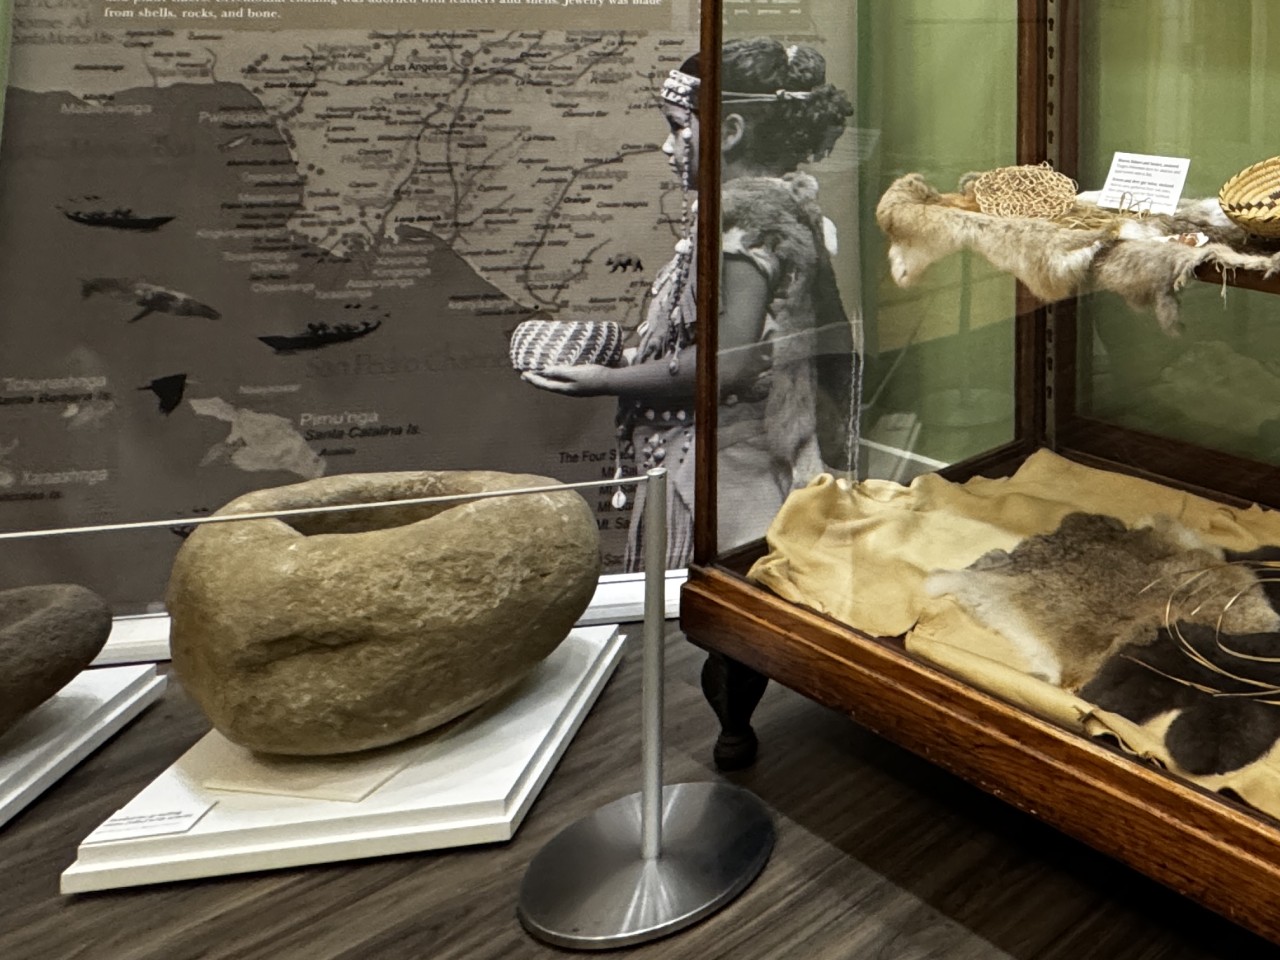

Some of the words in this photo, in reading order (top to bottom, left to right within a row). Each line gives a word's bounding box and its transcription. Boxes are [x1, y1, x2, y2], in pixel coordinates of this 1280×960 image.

[103, 7, 134, 17] from
[220, 7, 243, 18] and
[388, 63, 406, 72] Los
[408, 63, 448, 73] Angeles
[304, 427, 347, 441] Santa
[349, 425, 403, 439] Catalina
[559, 452, 578, 463] The
[582, 451, 606, 462] Four
